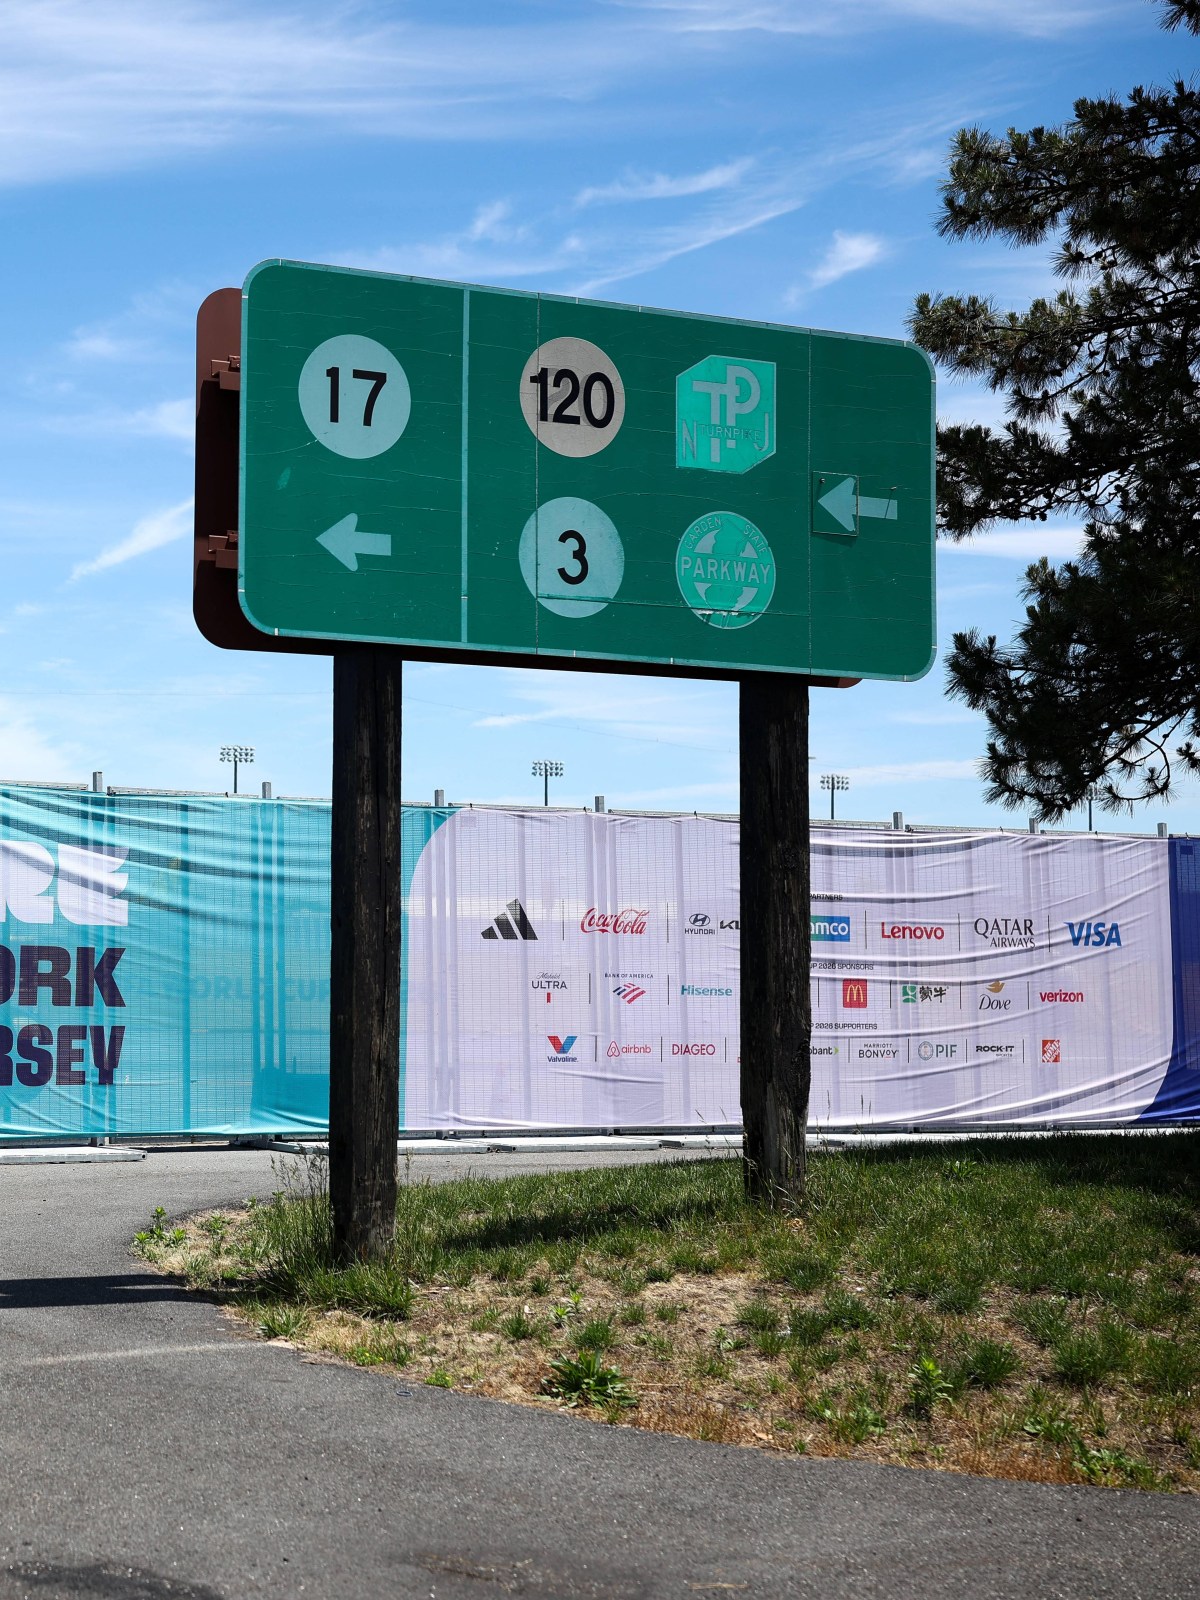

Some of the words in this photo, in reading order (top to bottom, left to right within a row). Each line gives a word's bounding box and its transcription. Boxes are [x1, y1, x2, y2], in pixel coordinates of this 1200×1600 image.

[325, 366, 387, 427] 17
[529, 367, 615, 429] 120
[684, 516, 722, 549] GARDEN
[743, 524, 768, 554] STATE
[557, 529, 589, 585] 3
[681, 556, 771, 585] PARKWAY
[581, 908, 650, 935] Coca-Cola
[974, 917, 1035, 939] QATAR
[684, 928, 715, 936] HYUNDAI
[881, 921, 945, 940] Lenovo
[1063, 921, 1122, 947] VISA
[989, 937, 1036, 949] AIRWAYS
[531, 980, 568, 990] ULTRA
[681, 985, 733, 997] Hisense
[978, 993, 1012, 1010] Dove
[1039, 989, 1084, 1003] verizon
[621, 1044, 652, 1055] airbnb
[672, 1044, 716, 1056] DIAGEO
[858, 1049, 898, 1059] BONVOY
[935, 1044, 958, 1058] PIF
[975, 1045, 1015, 1053] ROCK-IT
[547, 1055, 577, 1063] Valvoline
